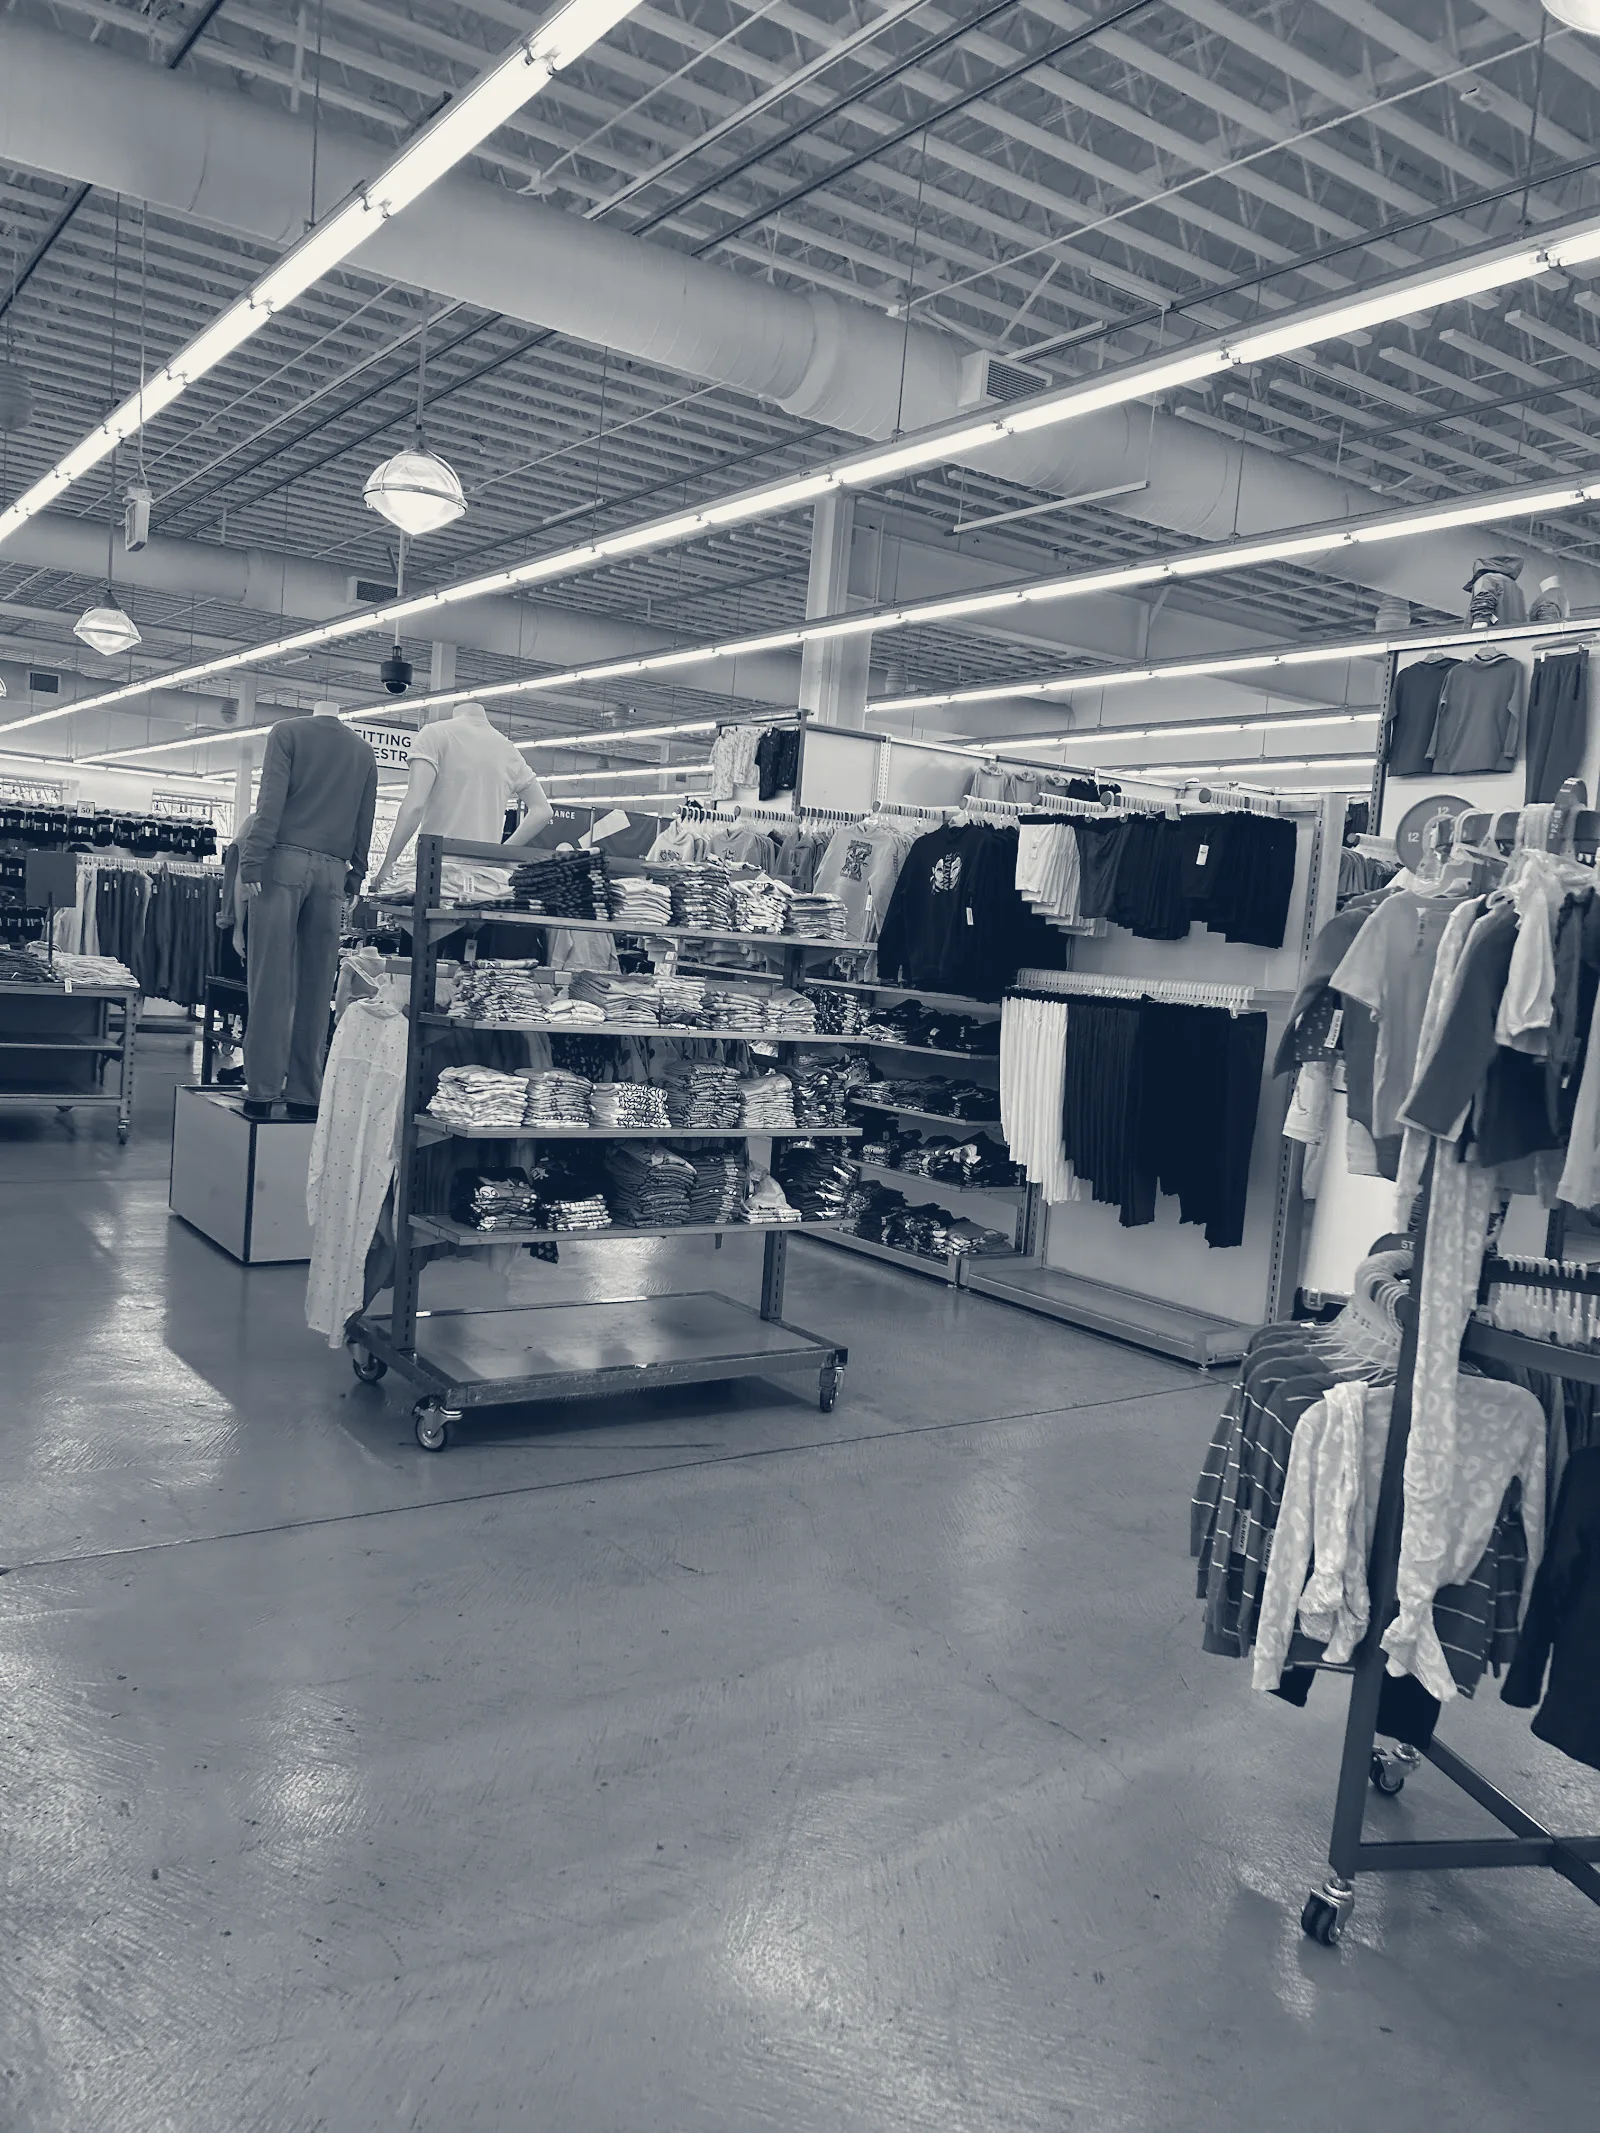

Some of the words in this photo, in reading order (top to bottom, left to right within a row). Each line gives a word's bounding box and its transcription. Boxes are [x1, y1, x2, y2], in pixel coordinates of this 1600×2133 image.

[1407, 832, 1420, 843] 12
[943, 852, 953, 891] AVATAR
[1401, 1240, 1415, 1250] 5T
